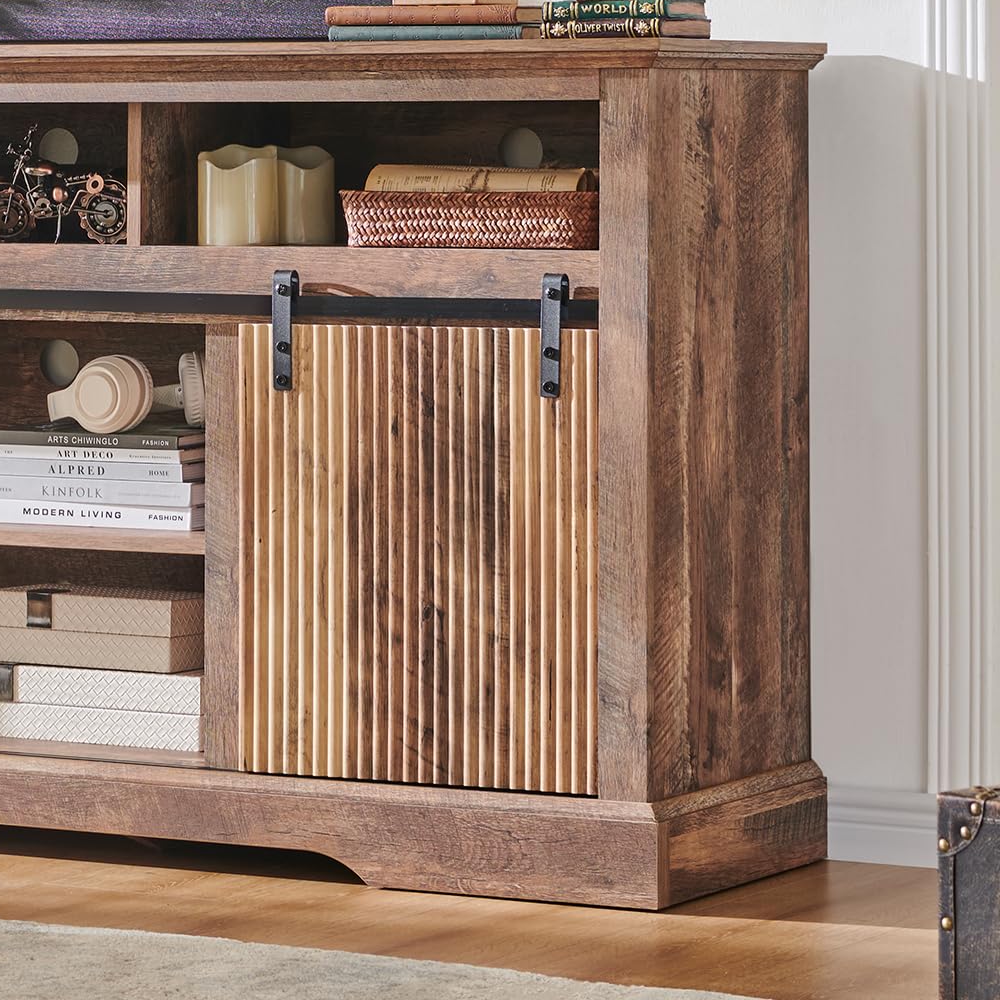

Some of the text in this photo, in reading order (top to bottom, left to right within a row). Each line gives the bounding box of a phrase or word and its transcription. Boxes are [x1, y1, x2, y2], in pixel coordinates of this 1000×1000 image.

[580, 3, 628, 14] WORLD
[575, 22, 625, 33] OLIVER TWIST
[47, 435, 119, 445] ARTS CHIWINGLO
[57, 450, 113, 459] ART DECO
[48, 464, 105, 475] ALPRED
[42, 485, 103, 498] KINFOLK
[22, 507, 122, 519] MODERN LIVING
